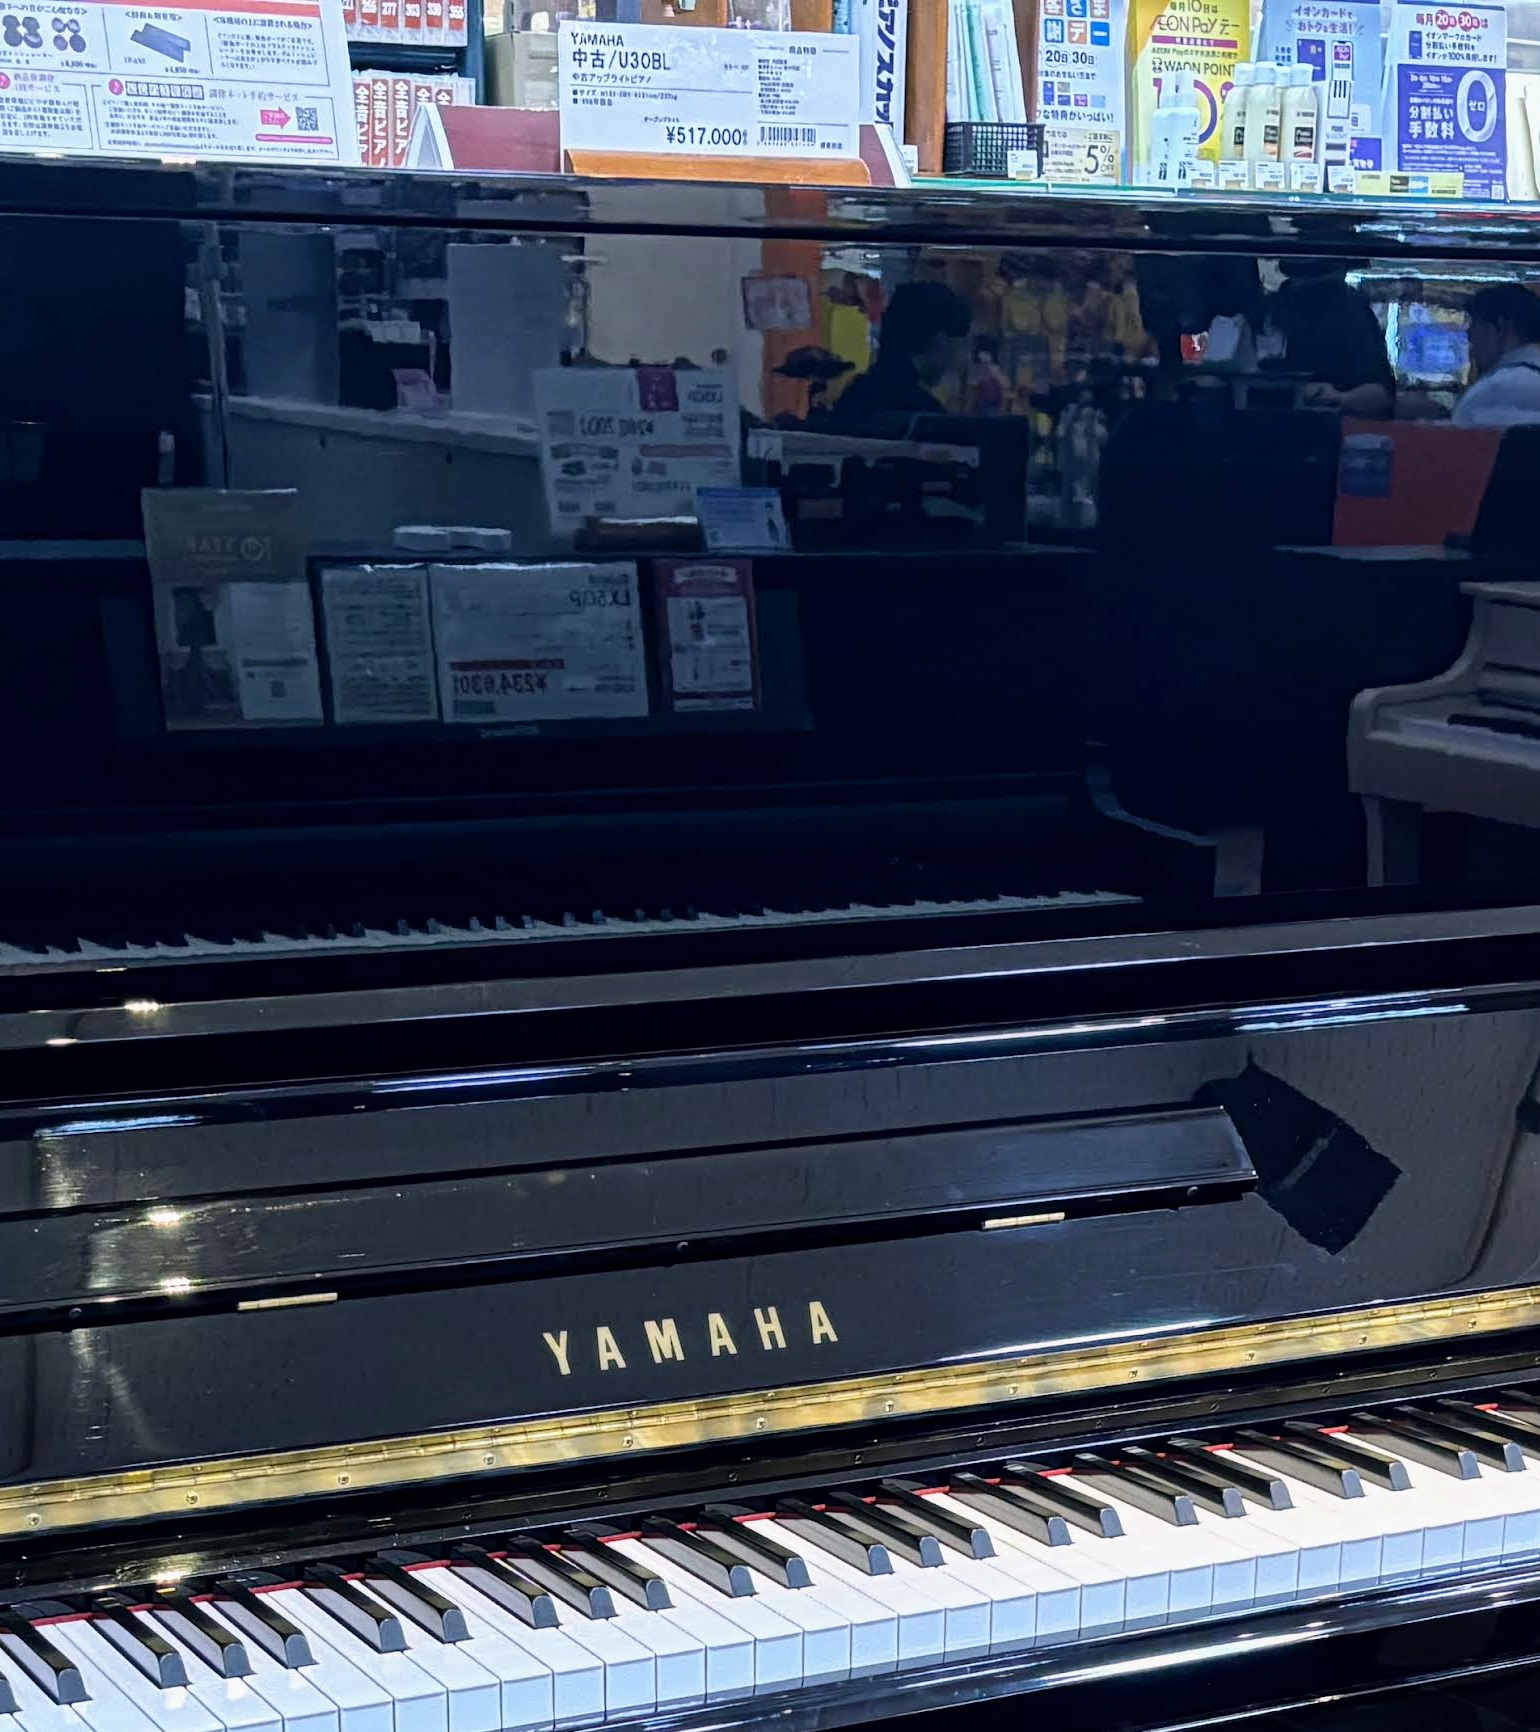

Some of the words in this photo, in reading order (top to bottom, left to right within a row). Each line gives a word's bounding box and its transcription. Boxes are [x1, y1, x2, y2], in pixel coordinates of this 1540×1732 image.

[571, 32, 624, 47] YAMAHA
[572, 48, 671, 71] 中古/U30BL
[1408, 105, 1454, 120] 分割払い
[1408, 121, 1455, 140] 手数料
[542, 1301, 839, 1375] YAMAHA
